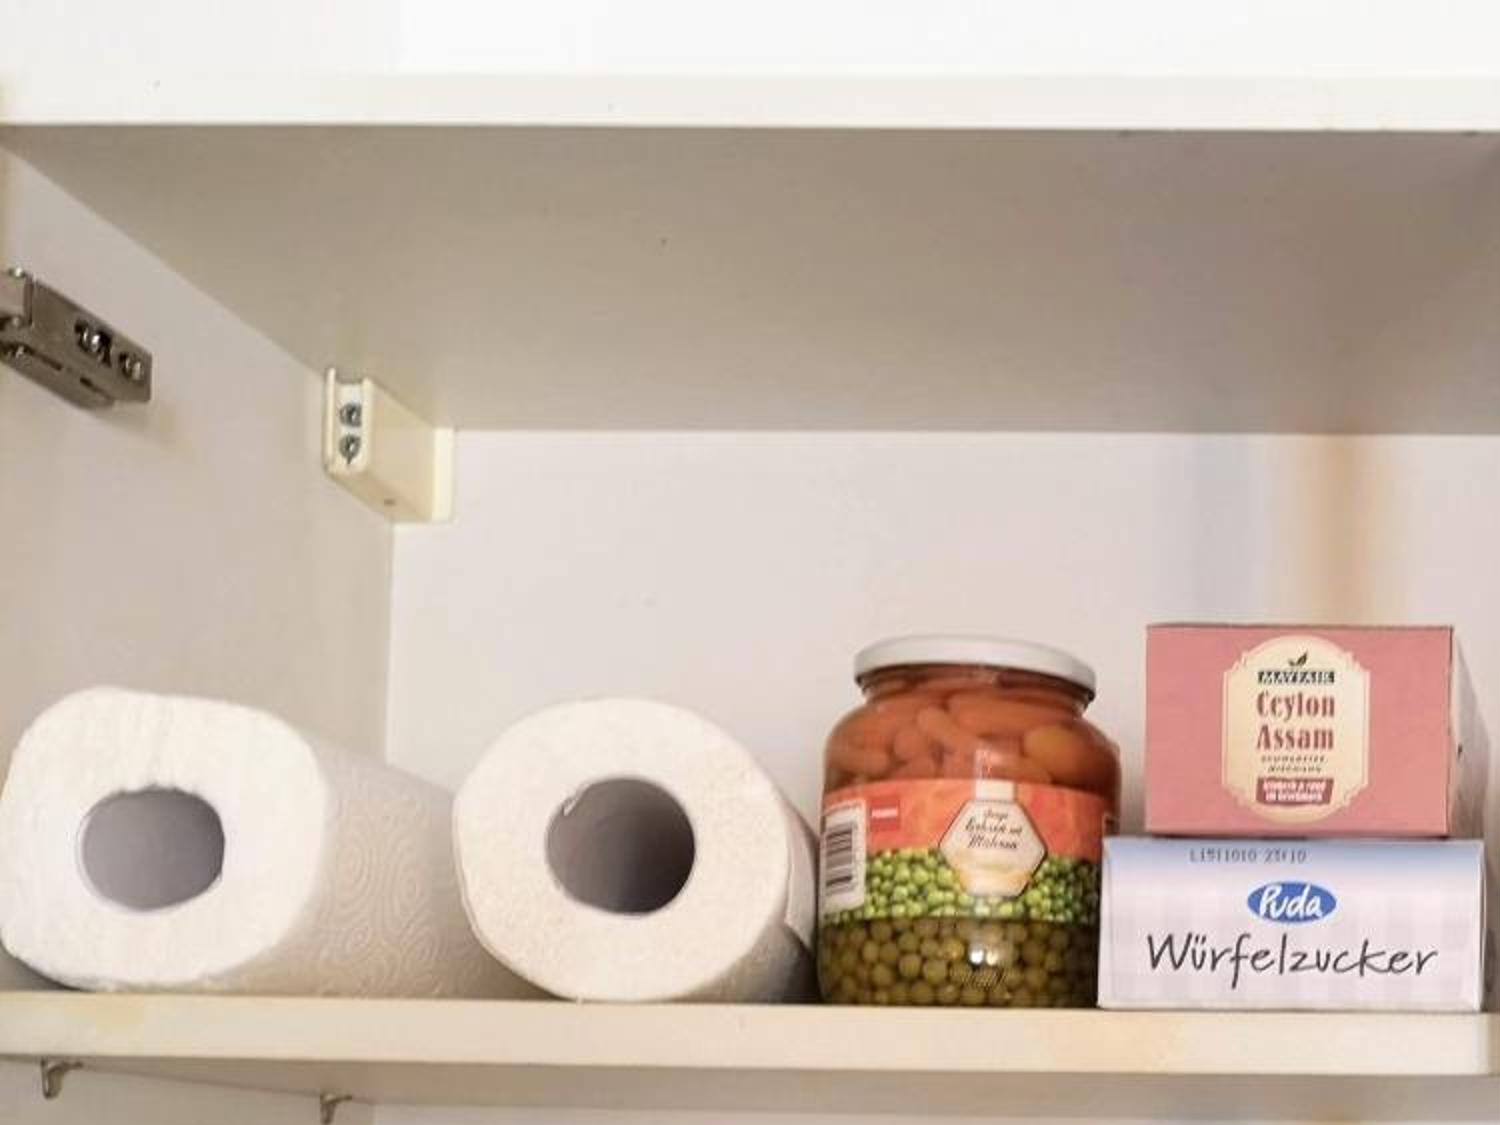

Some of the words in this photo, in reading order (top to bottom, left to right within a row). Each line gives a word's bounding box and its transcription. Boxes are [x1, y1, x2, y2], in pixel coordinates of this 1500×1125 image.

[1257, 690, 1335, 722] Ceylon
[1257, 724, 1334, 750] Assam
[1146, 932, 1438, 990] Würfelzucker
